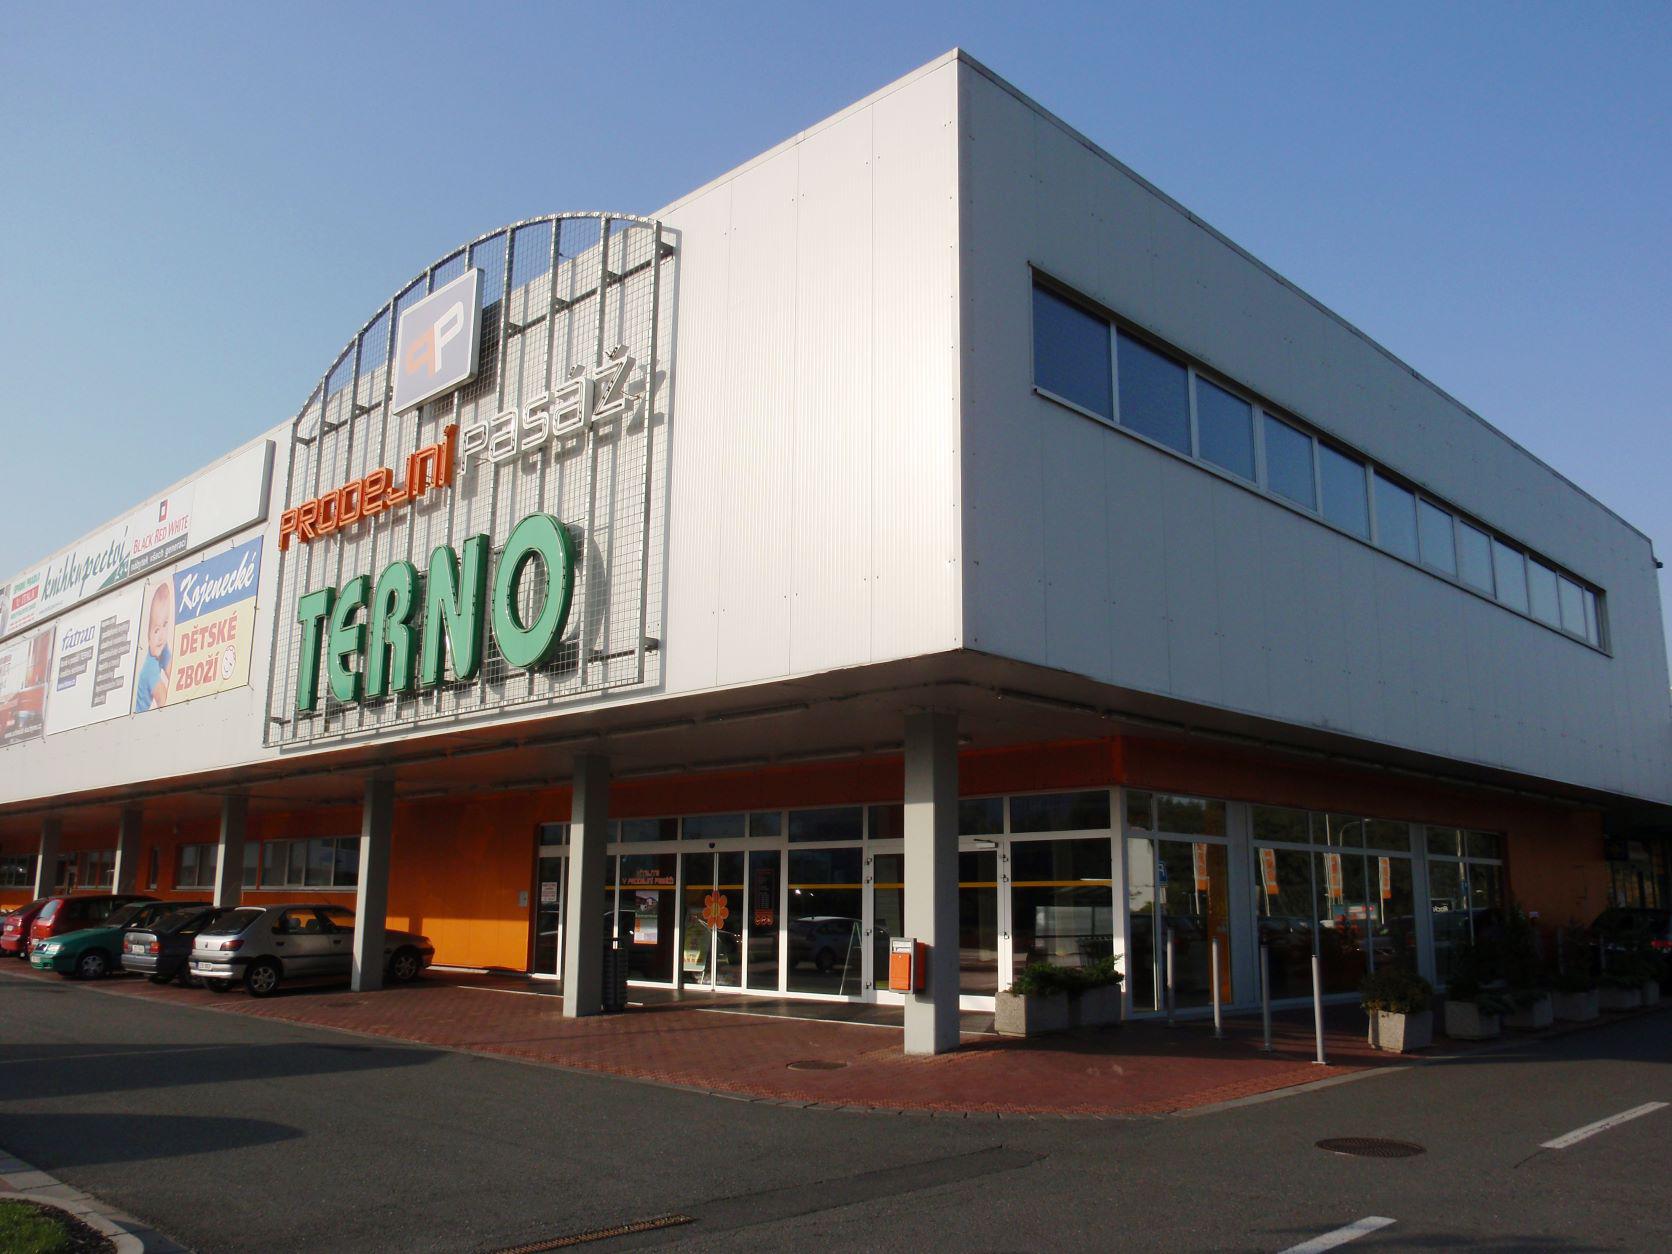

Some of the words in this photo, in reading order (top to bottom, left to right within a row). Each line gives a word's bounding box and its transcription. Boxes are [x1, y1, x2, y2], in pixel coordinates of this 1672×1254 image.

[133, 533, 153, 554] BLACK
[154, 526, 167, 543] RED
[168, 515, 188, 536] WHITE
[179, 551, 256, 617] Kojenecké
[179, 611, 238, 656] DĚTSKÉ
[298, 511, 575, 711] TERNO
[175, 651, 219, 692] ZBOŽÍ
